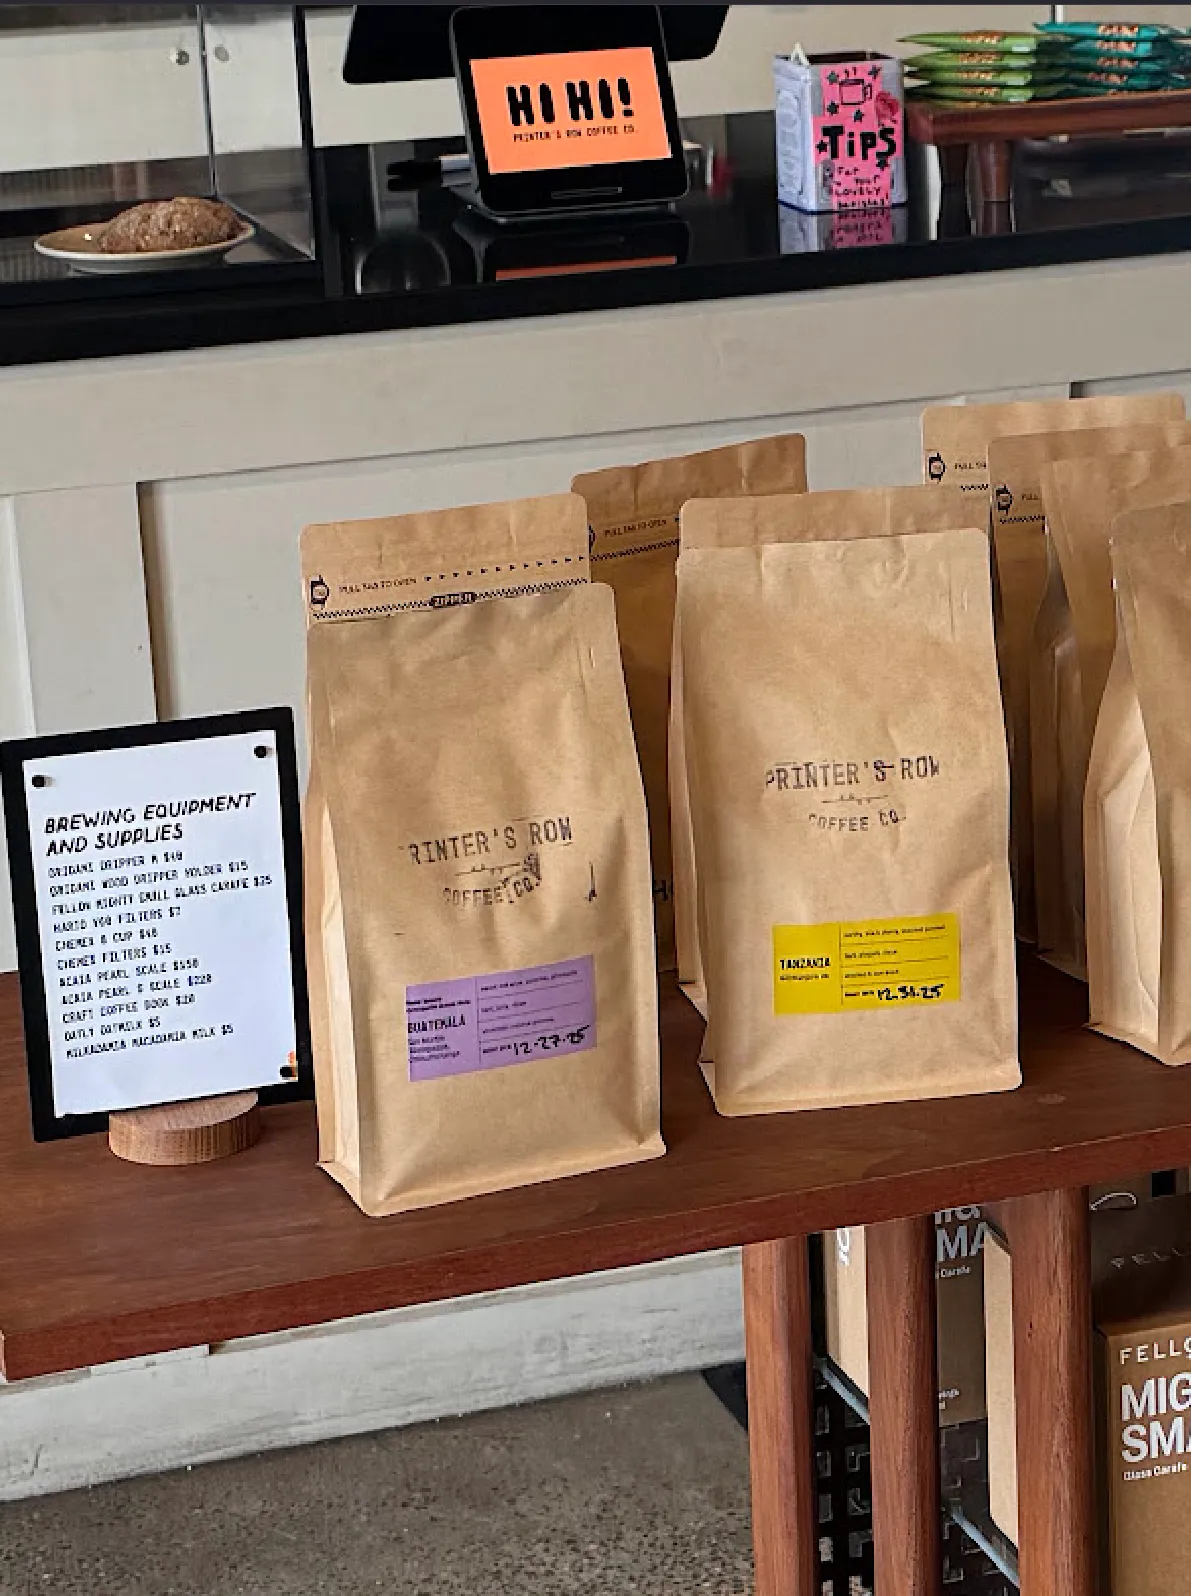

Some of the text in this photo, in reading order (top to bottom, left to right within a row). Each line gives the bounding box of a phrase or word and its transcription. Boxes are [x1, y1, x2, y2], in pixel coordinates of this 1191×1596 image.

[506, 77, 634, 126] HI HI!
[566, 129, 581, 138] ROW
[586, 125, 618, 136] COFFEE
[900, 755, 941, 780] ROW
[44, 792, 257, 834] BREWING EQUIPMENT
[808, 812, 869, 831] COFFEE
[46, 822, 183, 857] AND SUPPLIES
[529, 816, 573, 847] ROW
[48, 861, 94, 878] ORIGAMI
[100, 855, 145, 870] DRIPPER
[49, 880, 96, 897] ORIGAMI
[102, 876, 128, 889] WOOD
[133, 869, 179, 885] DRIPPER
[51, 900, 91, 915] FELLOW
[96, 894, 133, 910] MIGHTY
[139, 889, 170, 903] SMALL
[175, 883, 207, 898] GLASS
[53, 918, 87, 933] HARIO
[118, 907, 163, 923] FILTERS
[55, 936, 94, 951] CHEMEX
[112, 930, 133, 943] CUP
[57, 954, 96, 970] CHEMEX
[102, 946, 147, 963] FILTERS
[135, 961, 167, 976] SCALE
[779, 957, 831, 970] TANZANIA
[149, 977, 181, 992] SCALE
[62, 1008, 94, 1024] CRAFT
[100, 1001, 139, 1016] COFFEE
[64, 1027, 94, 1042] OATLY
[100, 1020, 143, 1036] OATMILK
[131, 1030, 187, 1048] MACADAMIA
[192, 1026, 216, 1040] MILK
[1123, 1461, 1188, 1481] Glass Carafe
